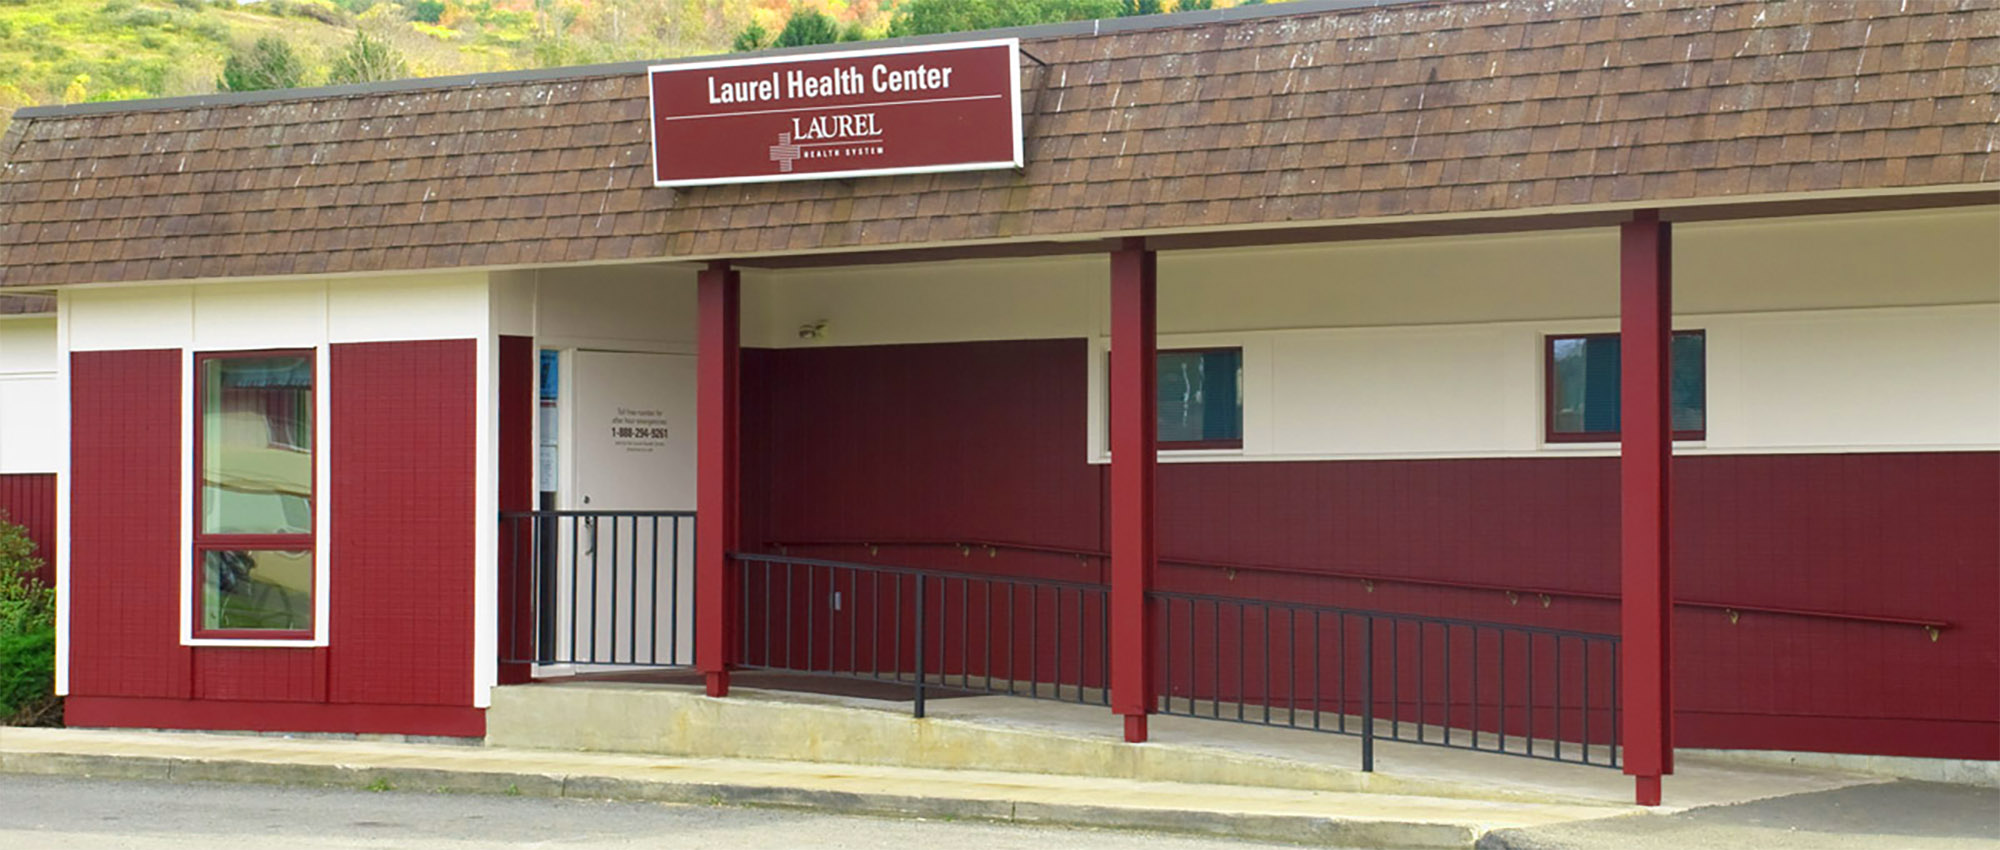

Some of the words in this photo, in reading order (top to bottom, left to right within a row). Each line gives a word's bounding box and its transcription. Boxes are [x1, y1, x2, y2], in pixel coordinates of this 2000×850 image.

[708, 72, 780, 105] Laurel
[787, 66, 865, 99] Health
[872, 63, 952, 93] Center
[792, 113, 883, 141] LAUREL
[803, 149, 840, 159] HEALTH
[845, 146, 884, 157] SYSTEM
